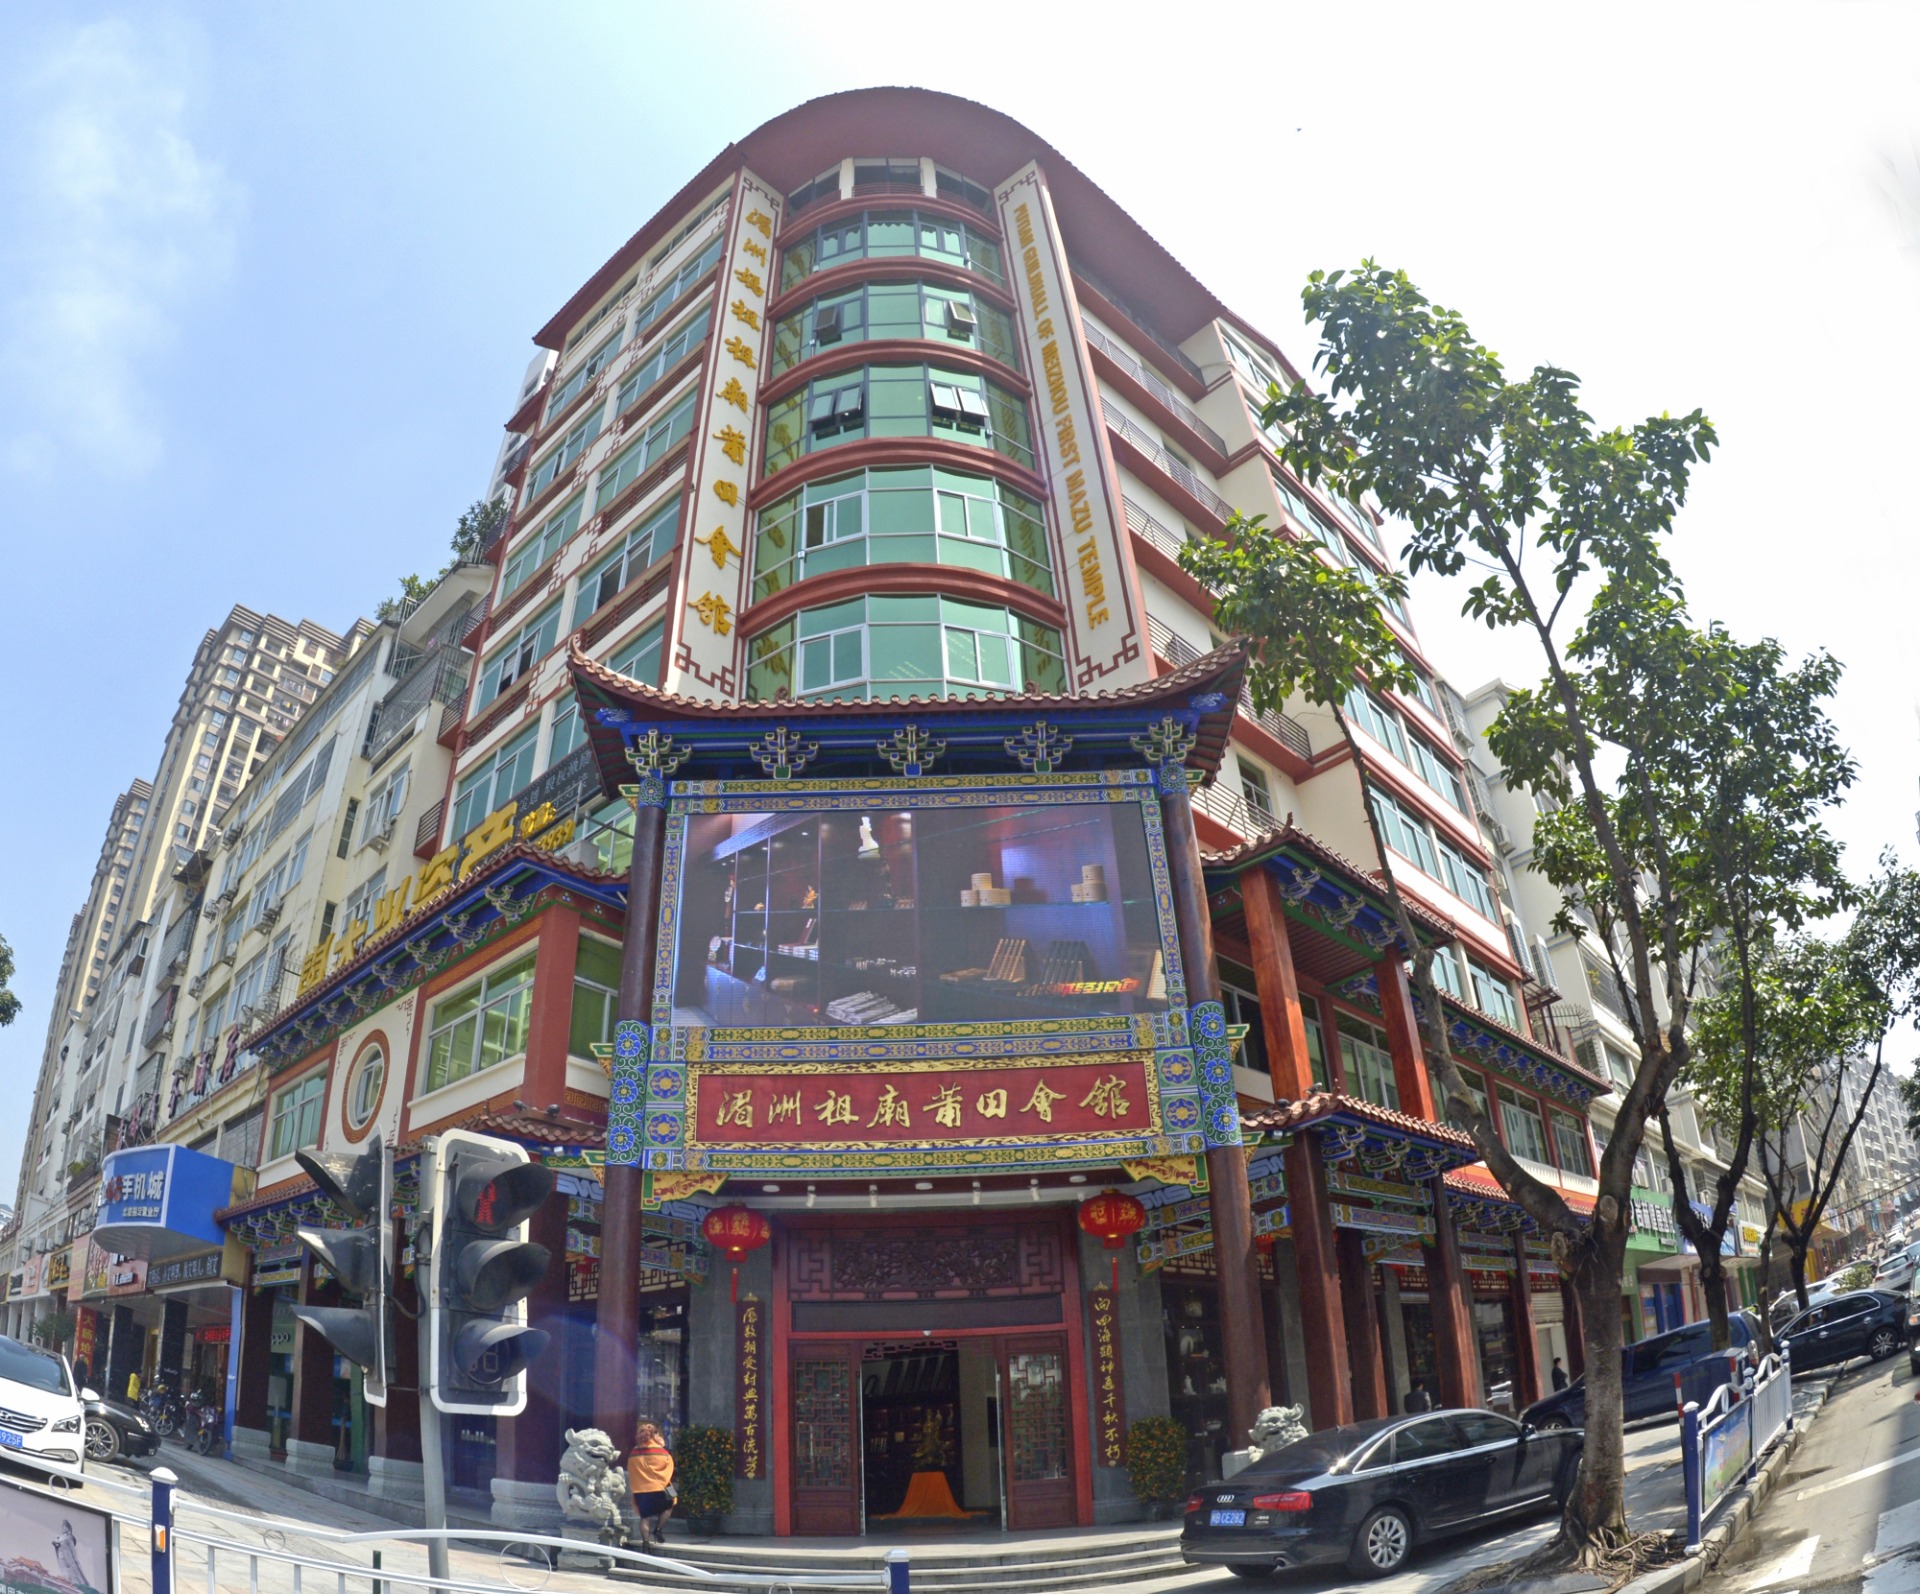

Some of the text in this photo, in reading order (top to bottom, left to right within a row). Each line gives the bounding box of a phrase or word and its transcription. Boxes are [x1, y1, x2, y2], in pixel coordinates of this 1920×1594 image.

[1013, 202, 1109, 630] PUTIAN GUILDHALL OF MEIZHOU FIRST MAZU TEMPLE
[0, 1430, 22, 1447] 925F
